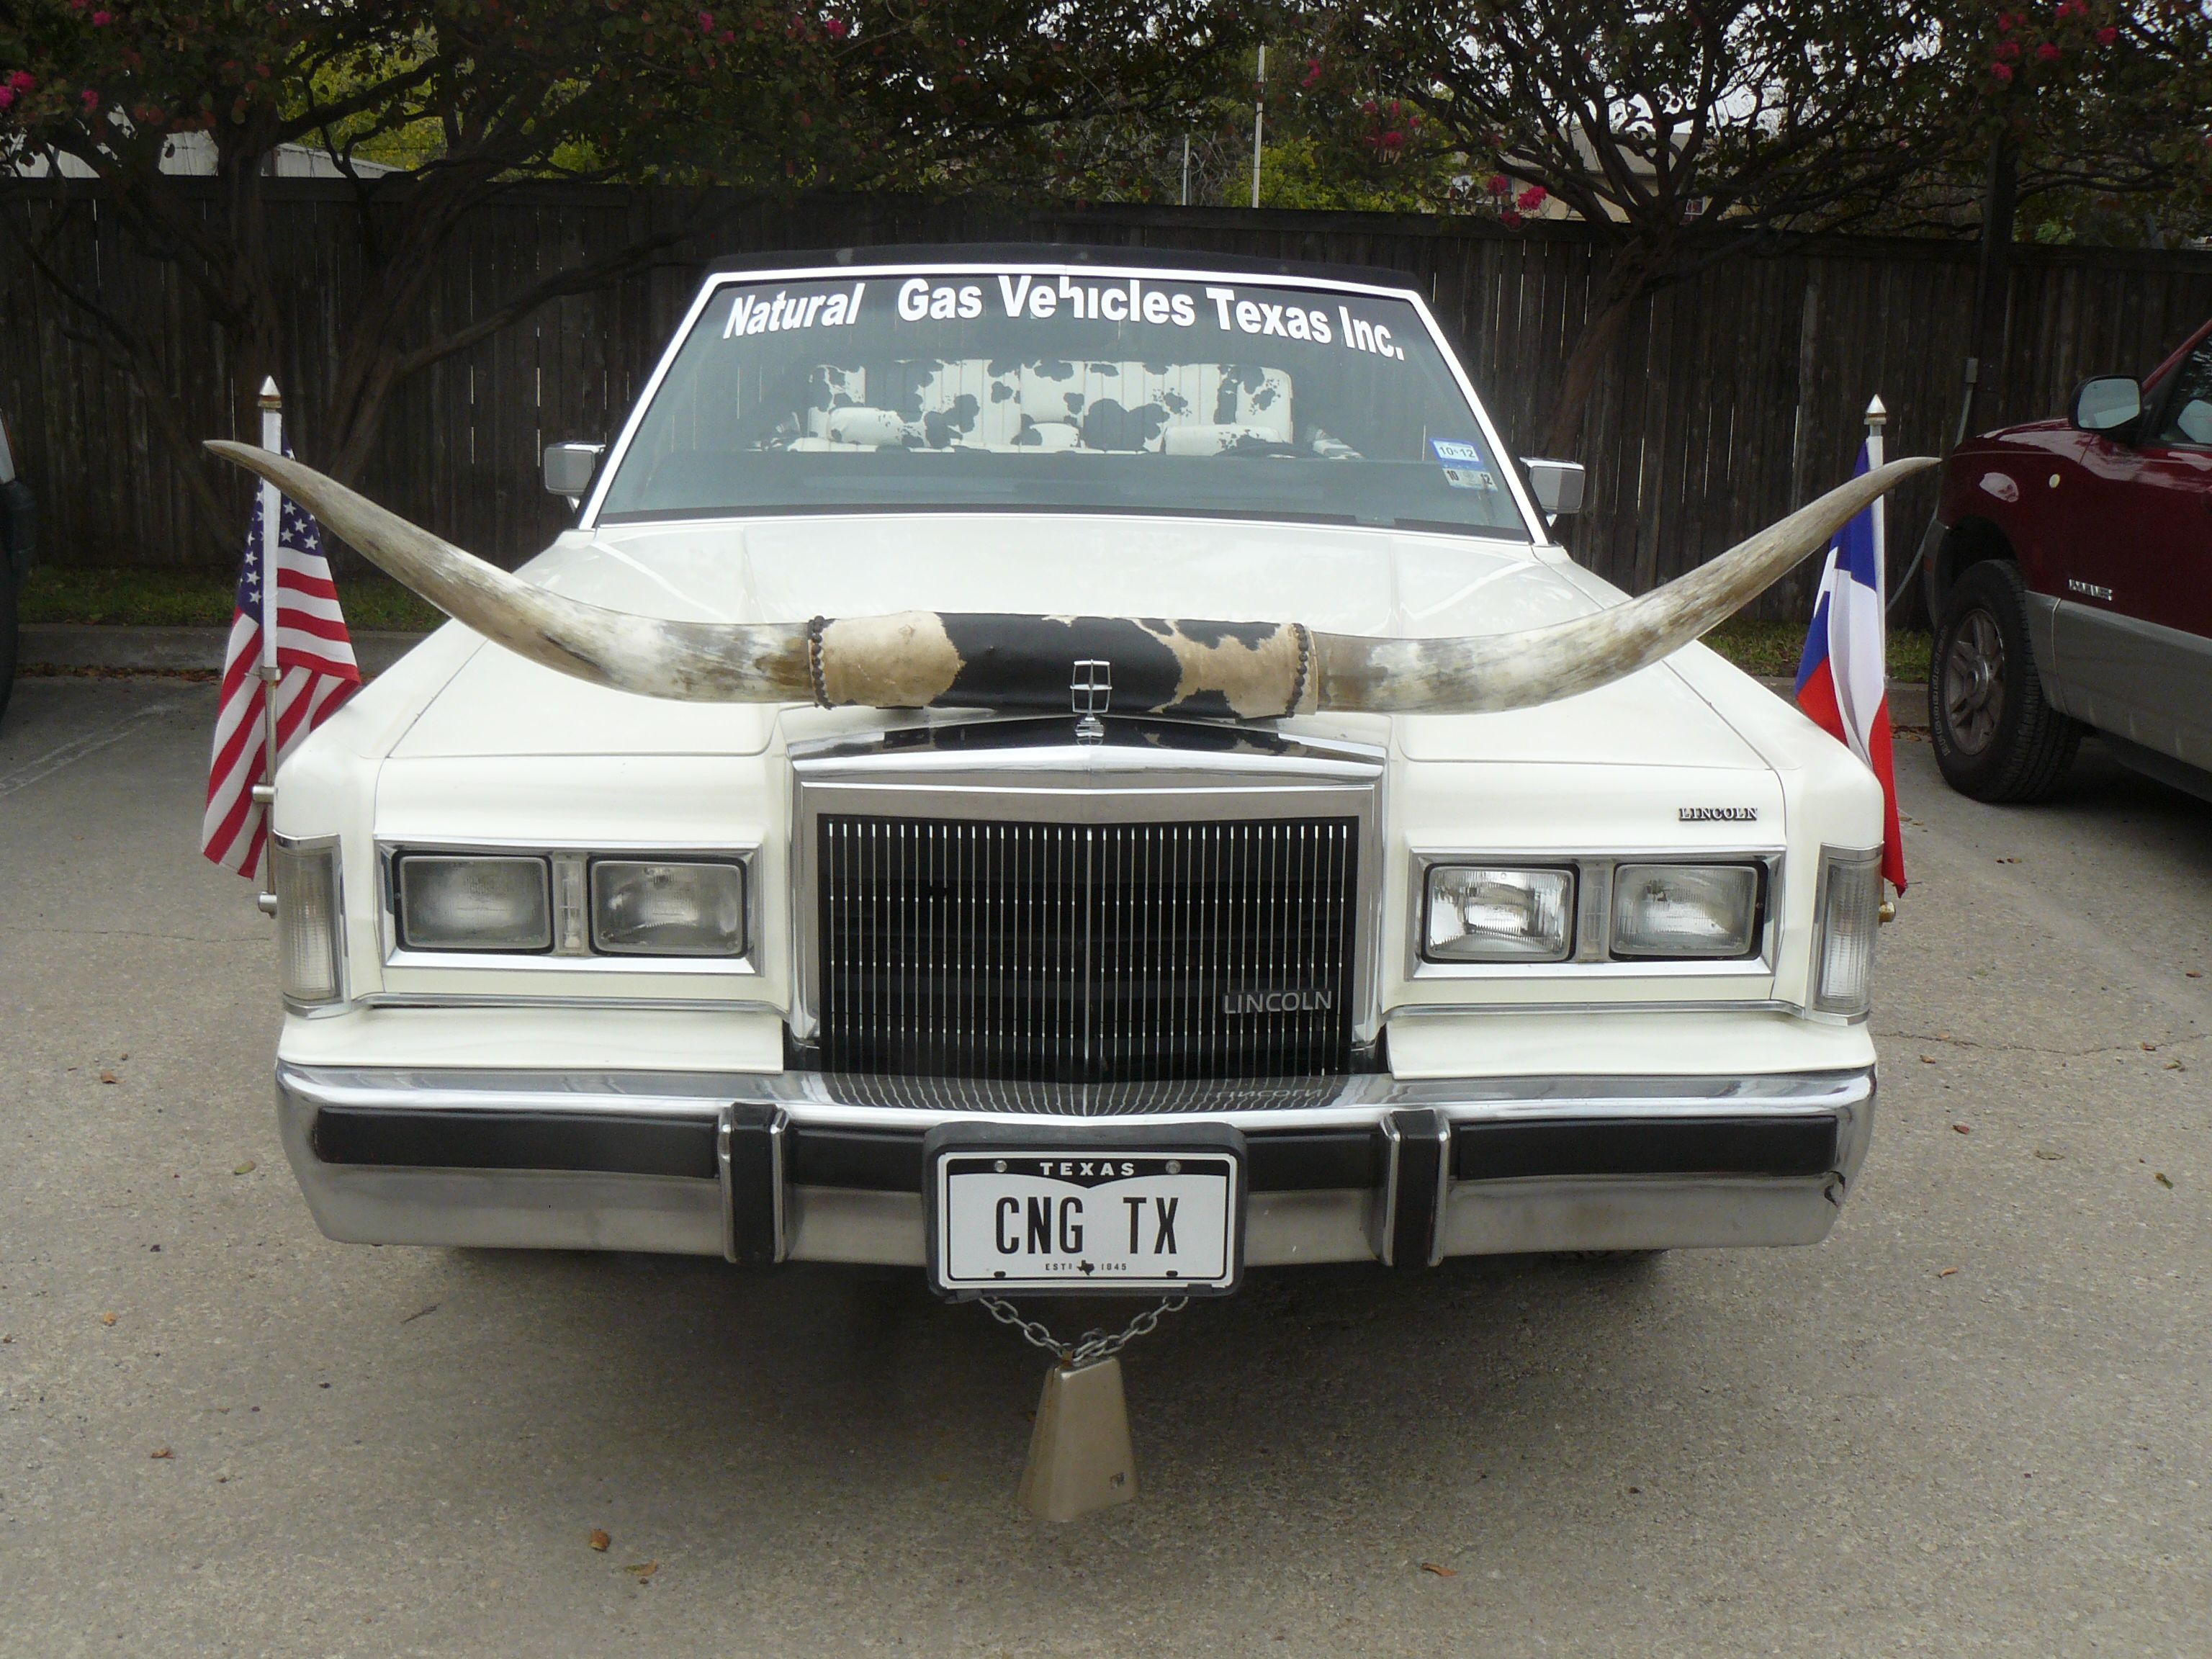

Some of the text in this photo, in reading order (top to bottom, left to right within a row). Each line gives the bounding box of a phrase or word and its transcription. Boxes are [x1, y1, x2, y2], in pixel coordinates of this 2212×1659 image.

[723, 275, 1405, 361] Natural Gas Vehicles Texas Inc.
[1678, 807, 1758, 822] LINCOLN
[1223, 990, 1332, 1015] LINCOLN
[1040, 1162, 1136, 1177] TEXAS
[995, 1196, 1179, 1254] CNG TX
